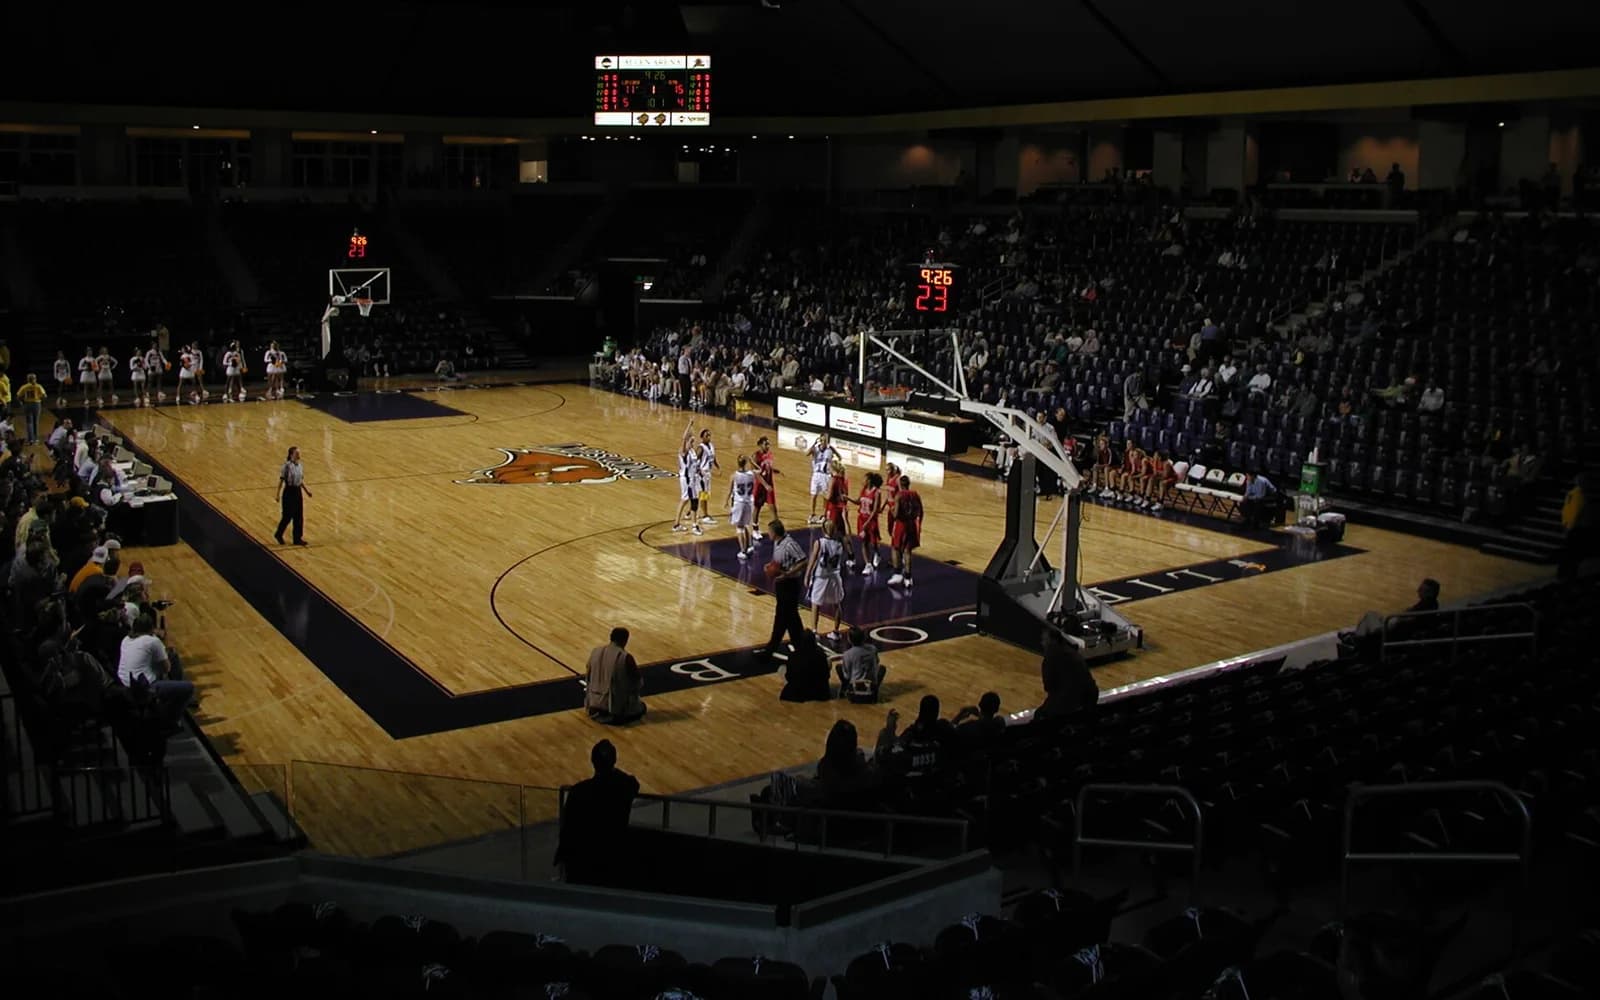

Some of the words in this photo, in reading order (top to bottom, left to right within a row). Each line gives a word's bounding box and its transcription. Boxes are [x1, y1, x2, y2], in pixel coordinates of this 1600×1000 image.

[348, 245, 365, 258] 23
[921, 269, 952, 285] 9:26
[915, 285, 948, 312] 23
[736, 481, 755, 496] 32
